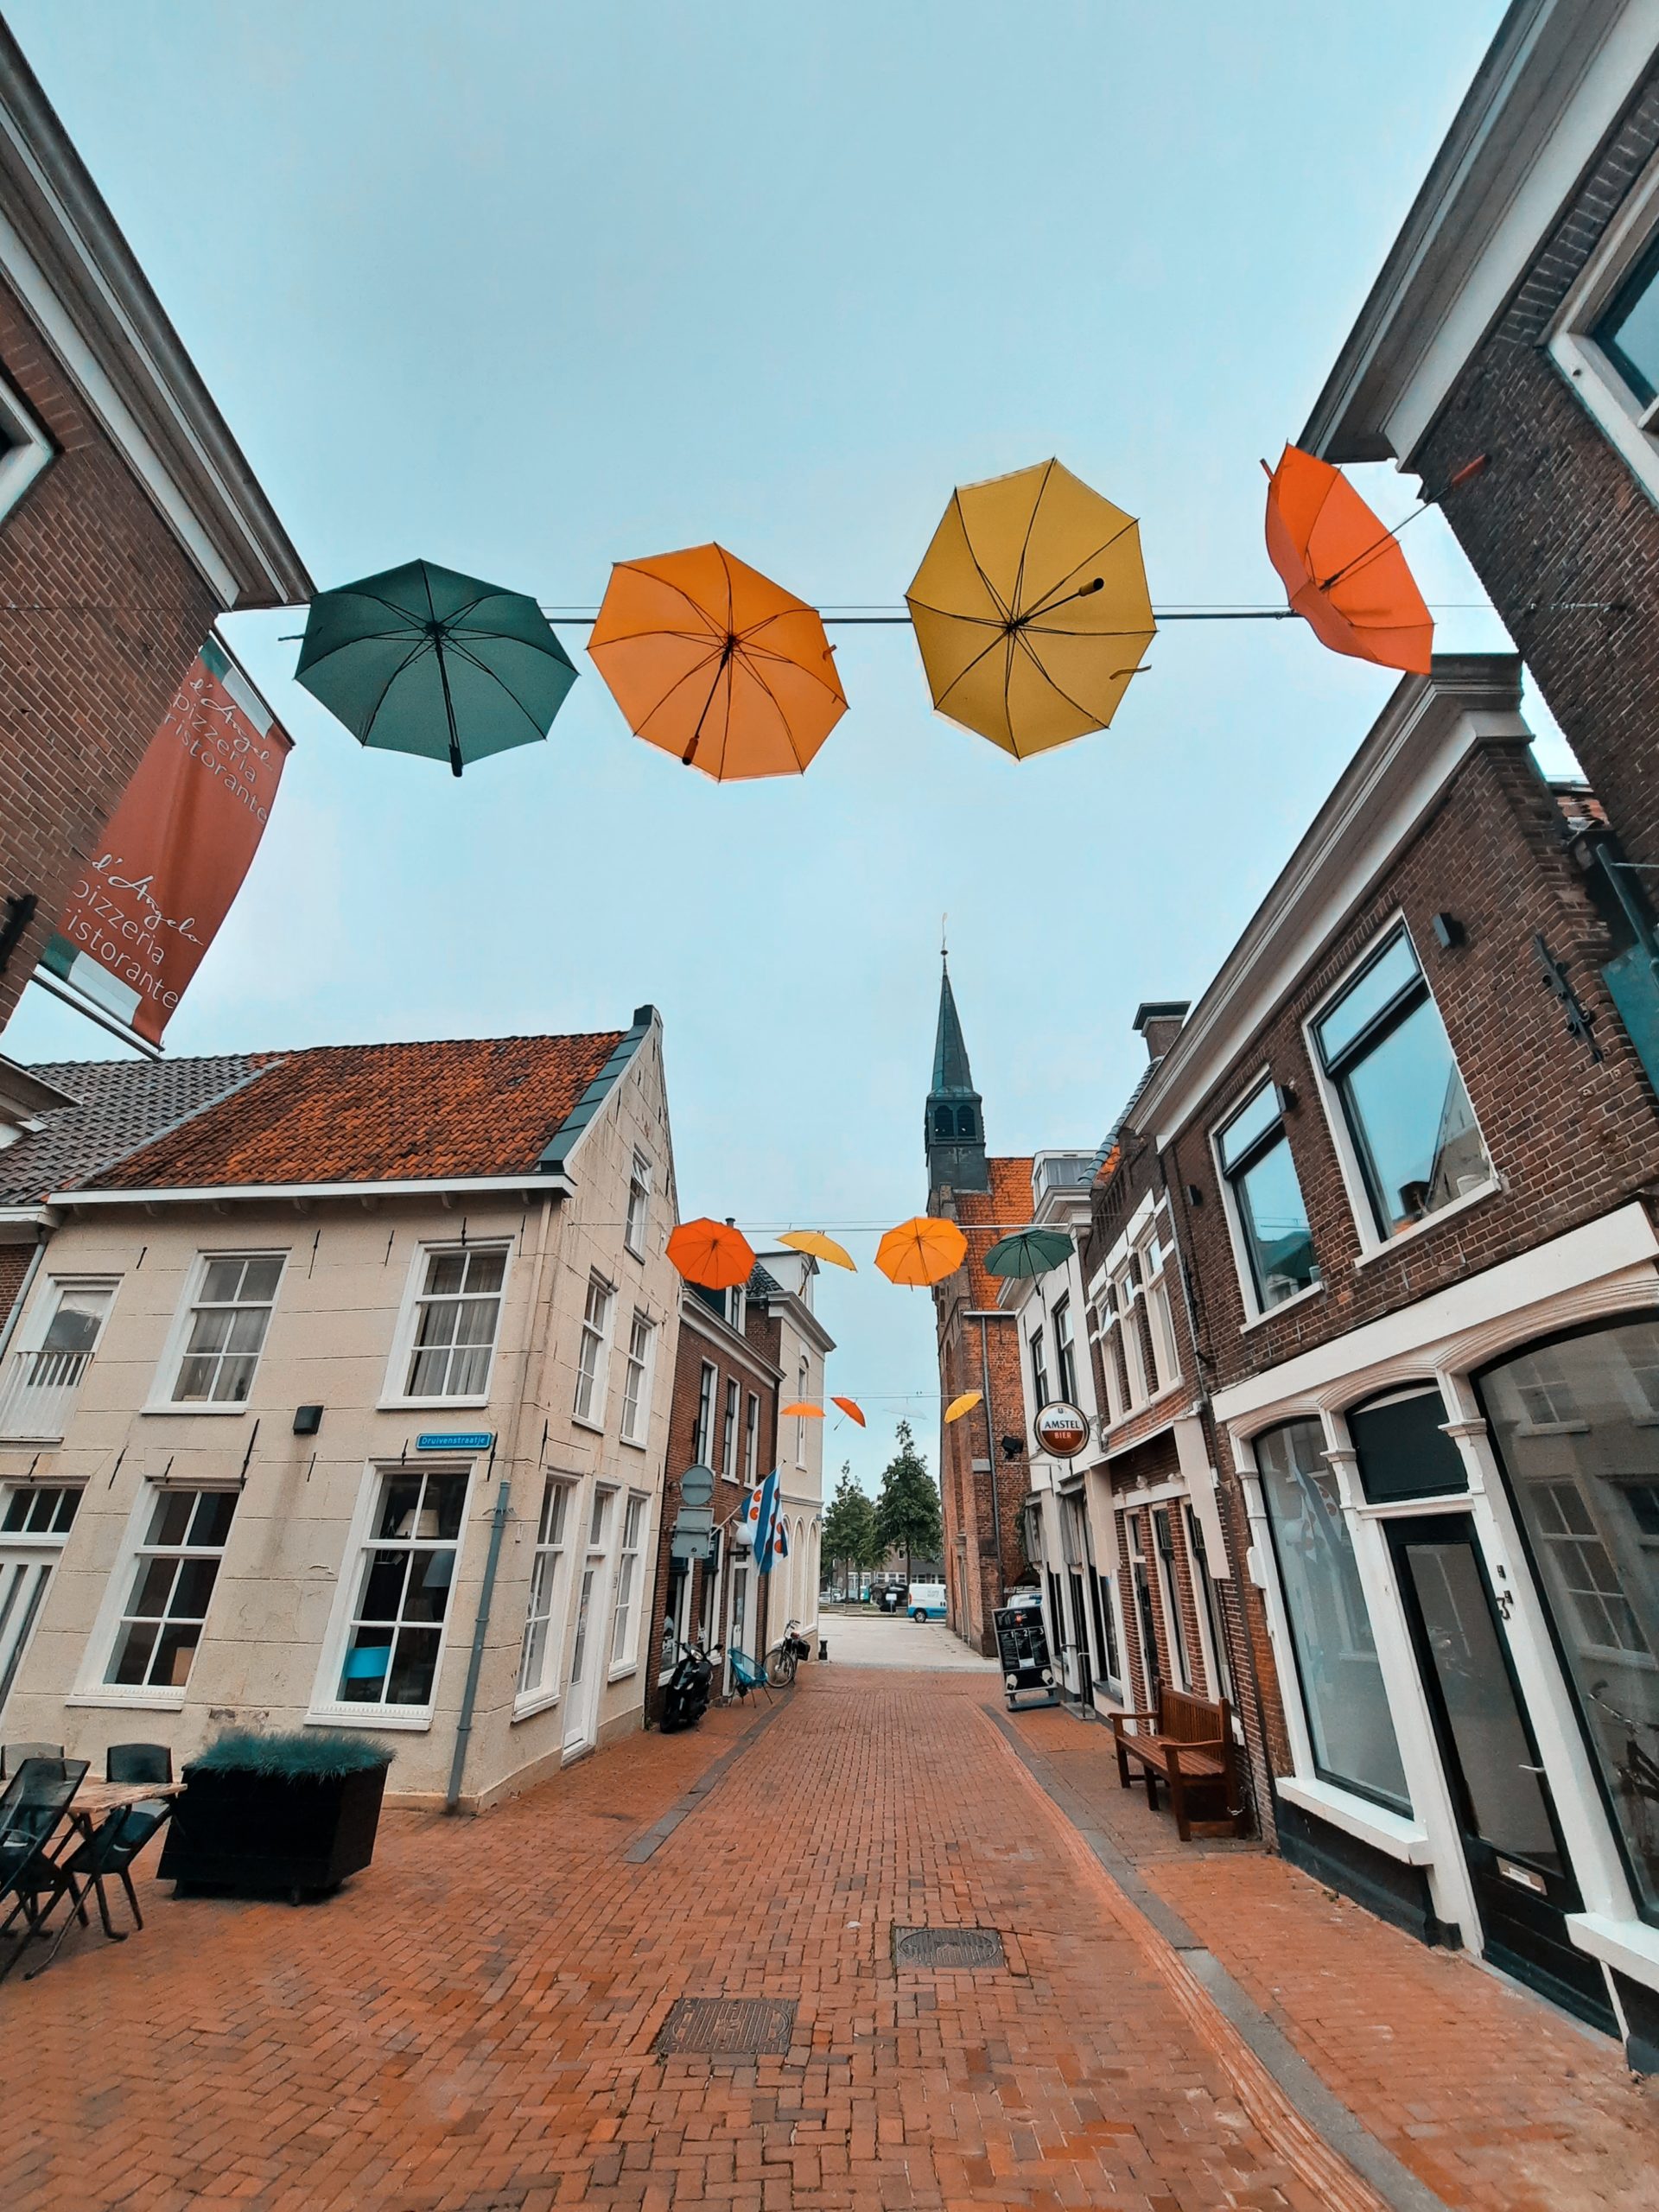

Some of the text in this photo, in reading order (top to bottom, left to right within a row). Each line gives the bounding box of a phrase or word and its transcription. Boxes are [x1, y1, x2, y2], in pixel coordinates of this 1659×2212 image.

[163, 712, 268, 822] ristorante
[172, 692, 257, 783] pizzeria
[92, 854, 204, 946] d'Angelo
[65, 907, 180, 1009] istorante
[421, 1435, 486, 1446] Druivenstraatje
[1044, 1420, 1081, 1429] AMSTEL
[1053, 1431, 1072, 1440] BIER
